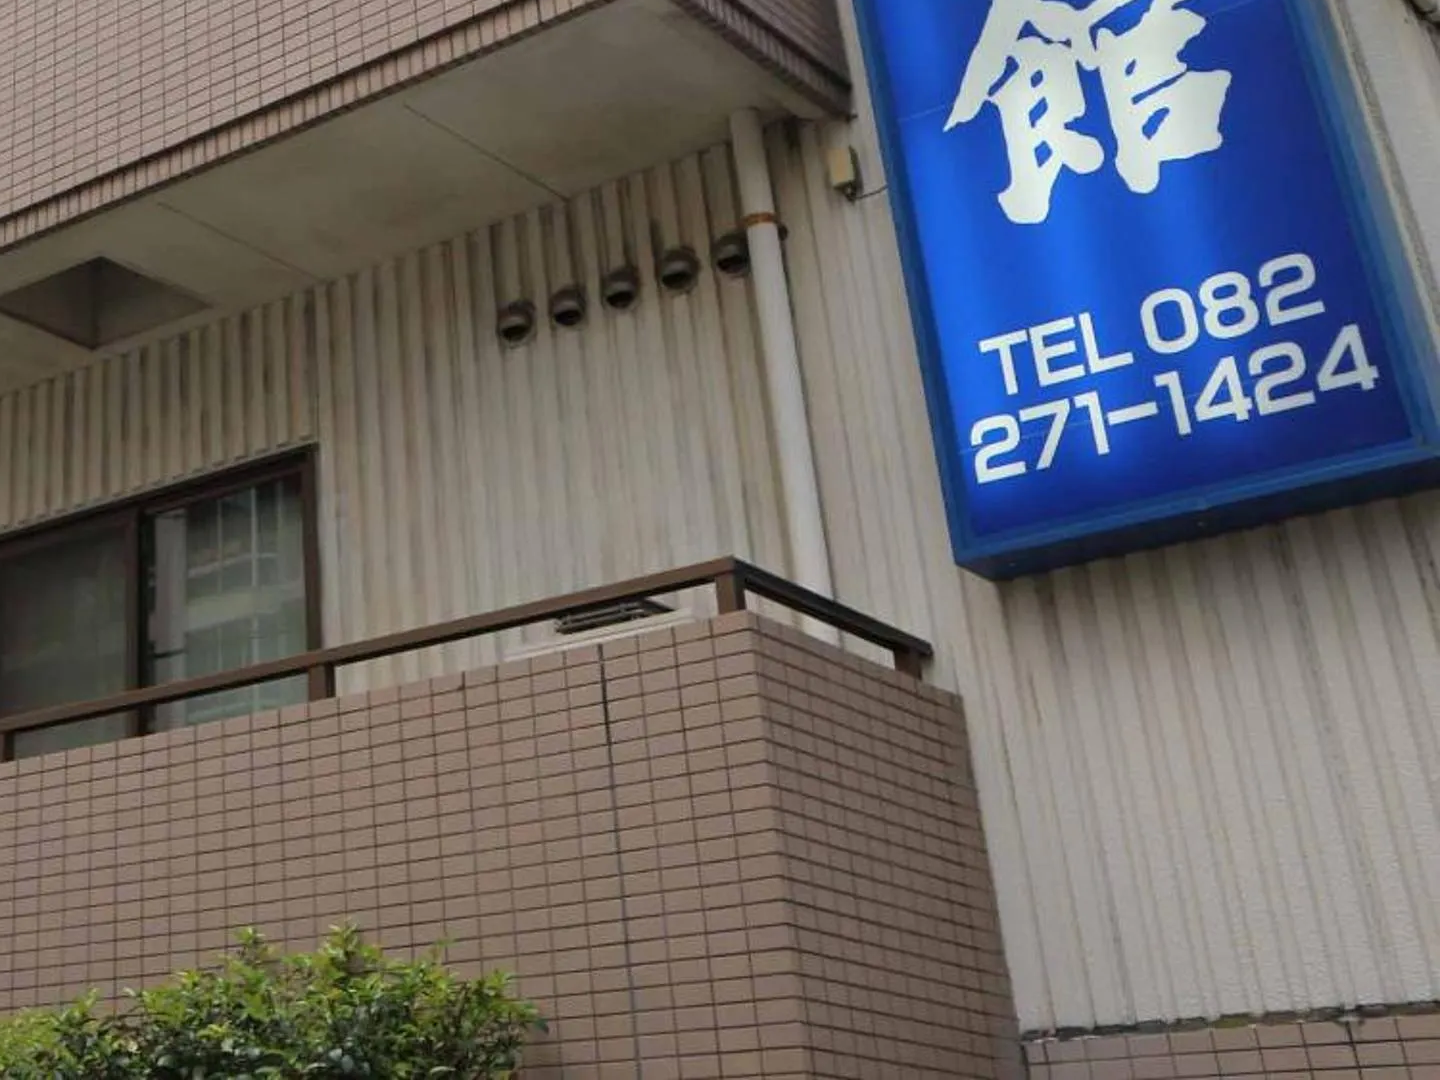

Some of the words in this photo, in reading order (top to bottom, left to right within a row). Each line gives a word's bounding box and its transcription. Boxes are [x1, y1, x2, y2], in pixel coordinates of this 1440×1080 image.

[978, 311, 1134, 396] TEL
[1140, 253, 1325, 354] 082
[970, 323, 1379, 484] 271-1424
